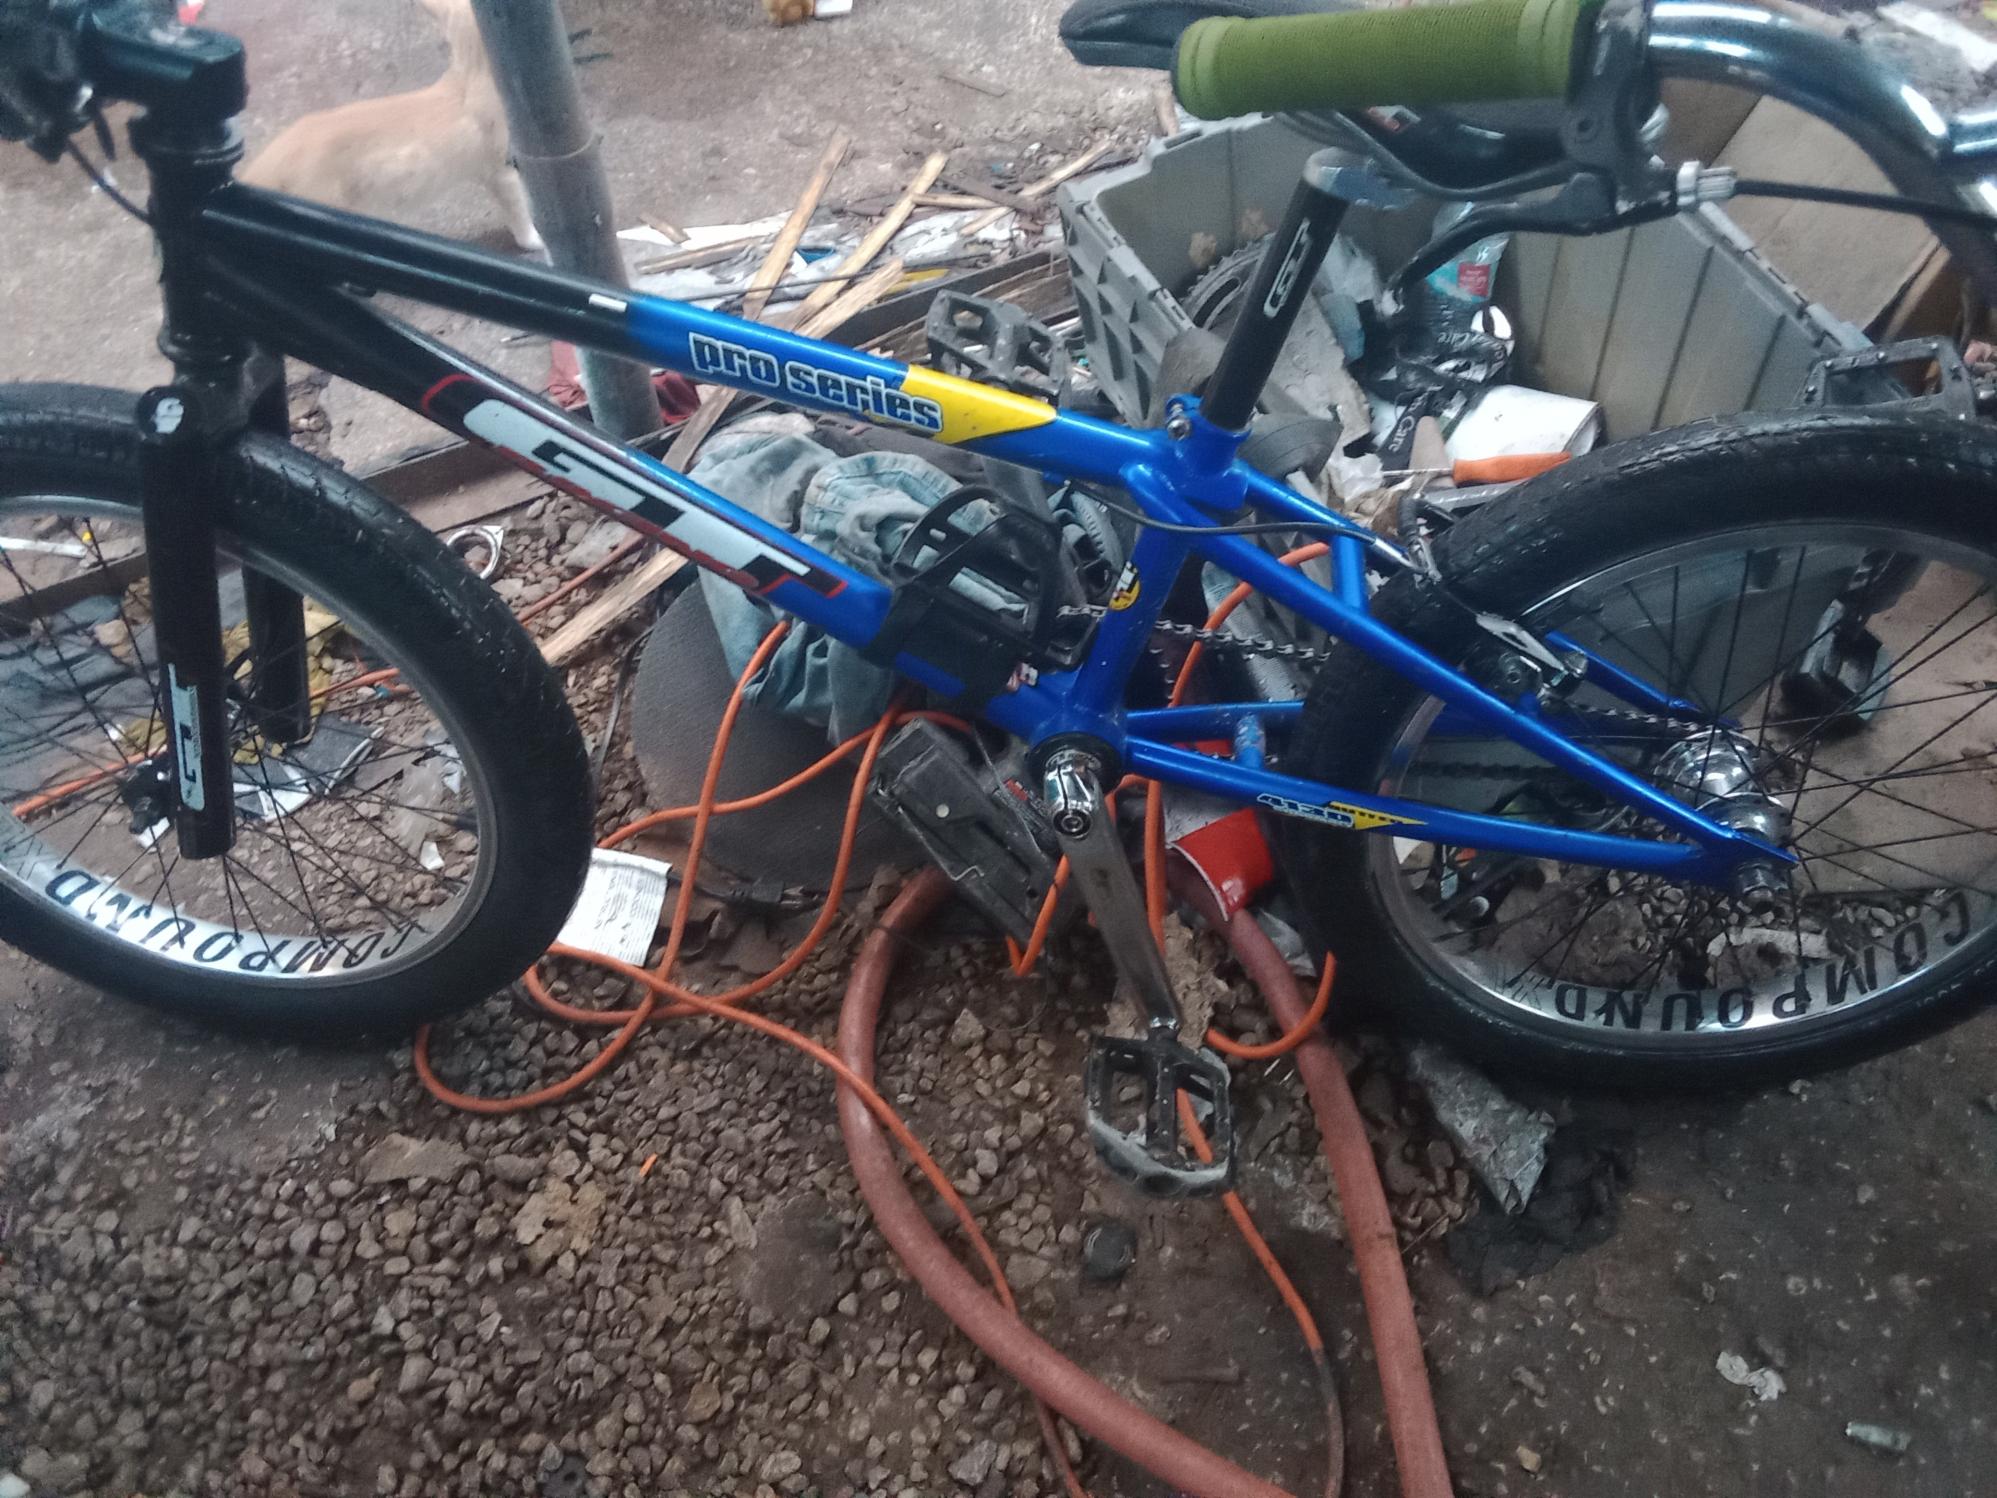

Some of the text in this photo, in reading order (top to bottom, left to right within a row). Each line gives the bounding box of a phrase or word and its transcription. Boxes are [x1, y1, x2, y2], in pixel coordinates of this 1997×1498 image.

[689, 332, 943, 433] pro series
[462, 399, 815, 578] GT
[1554, 890, 1971, 1032] COMPOUND
